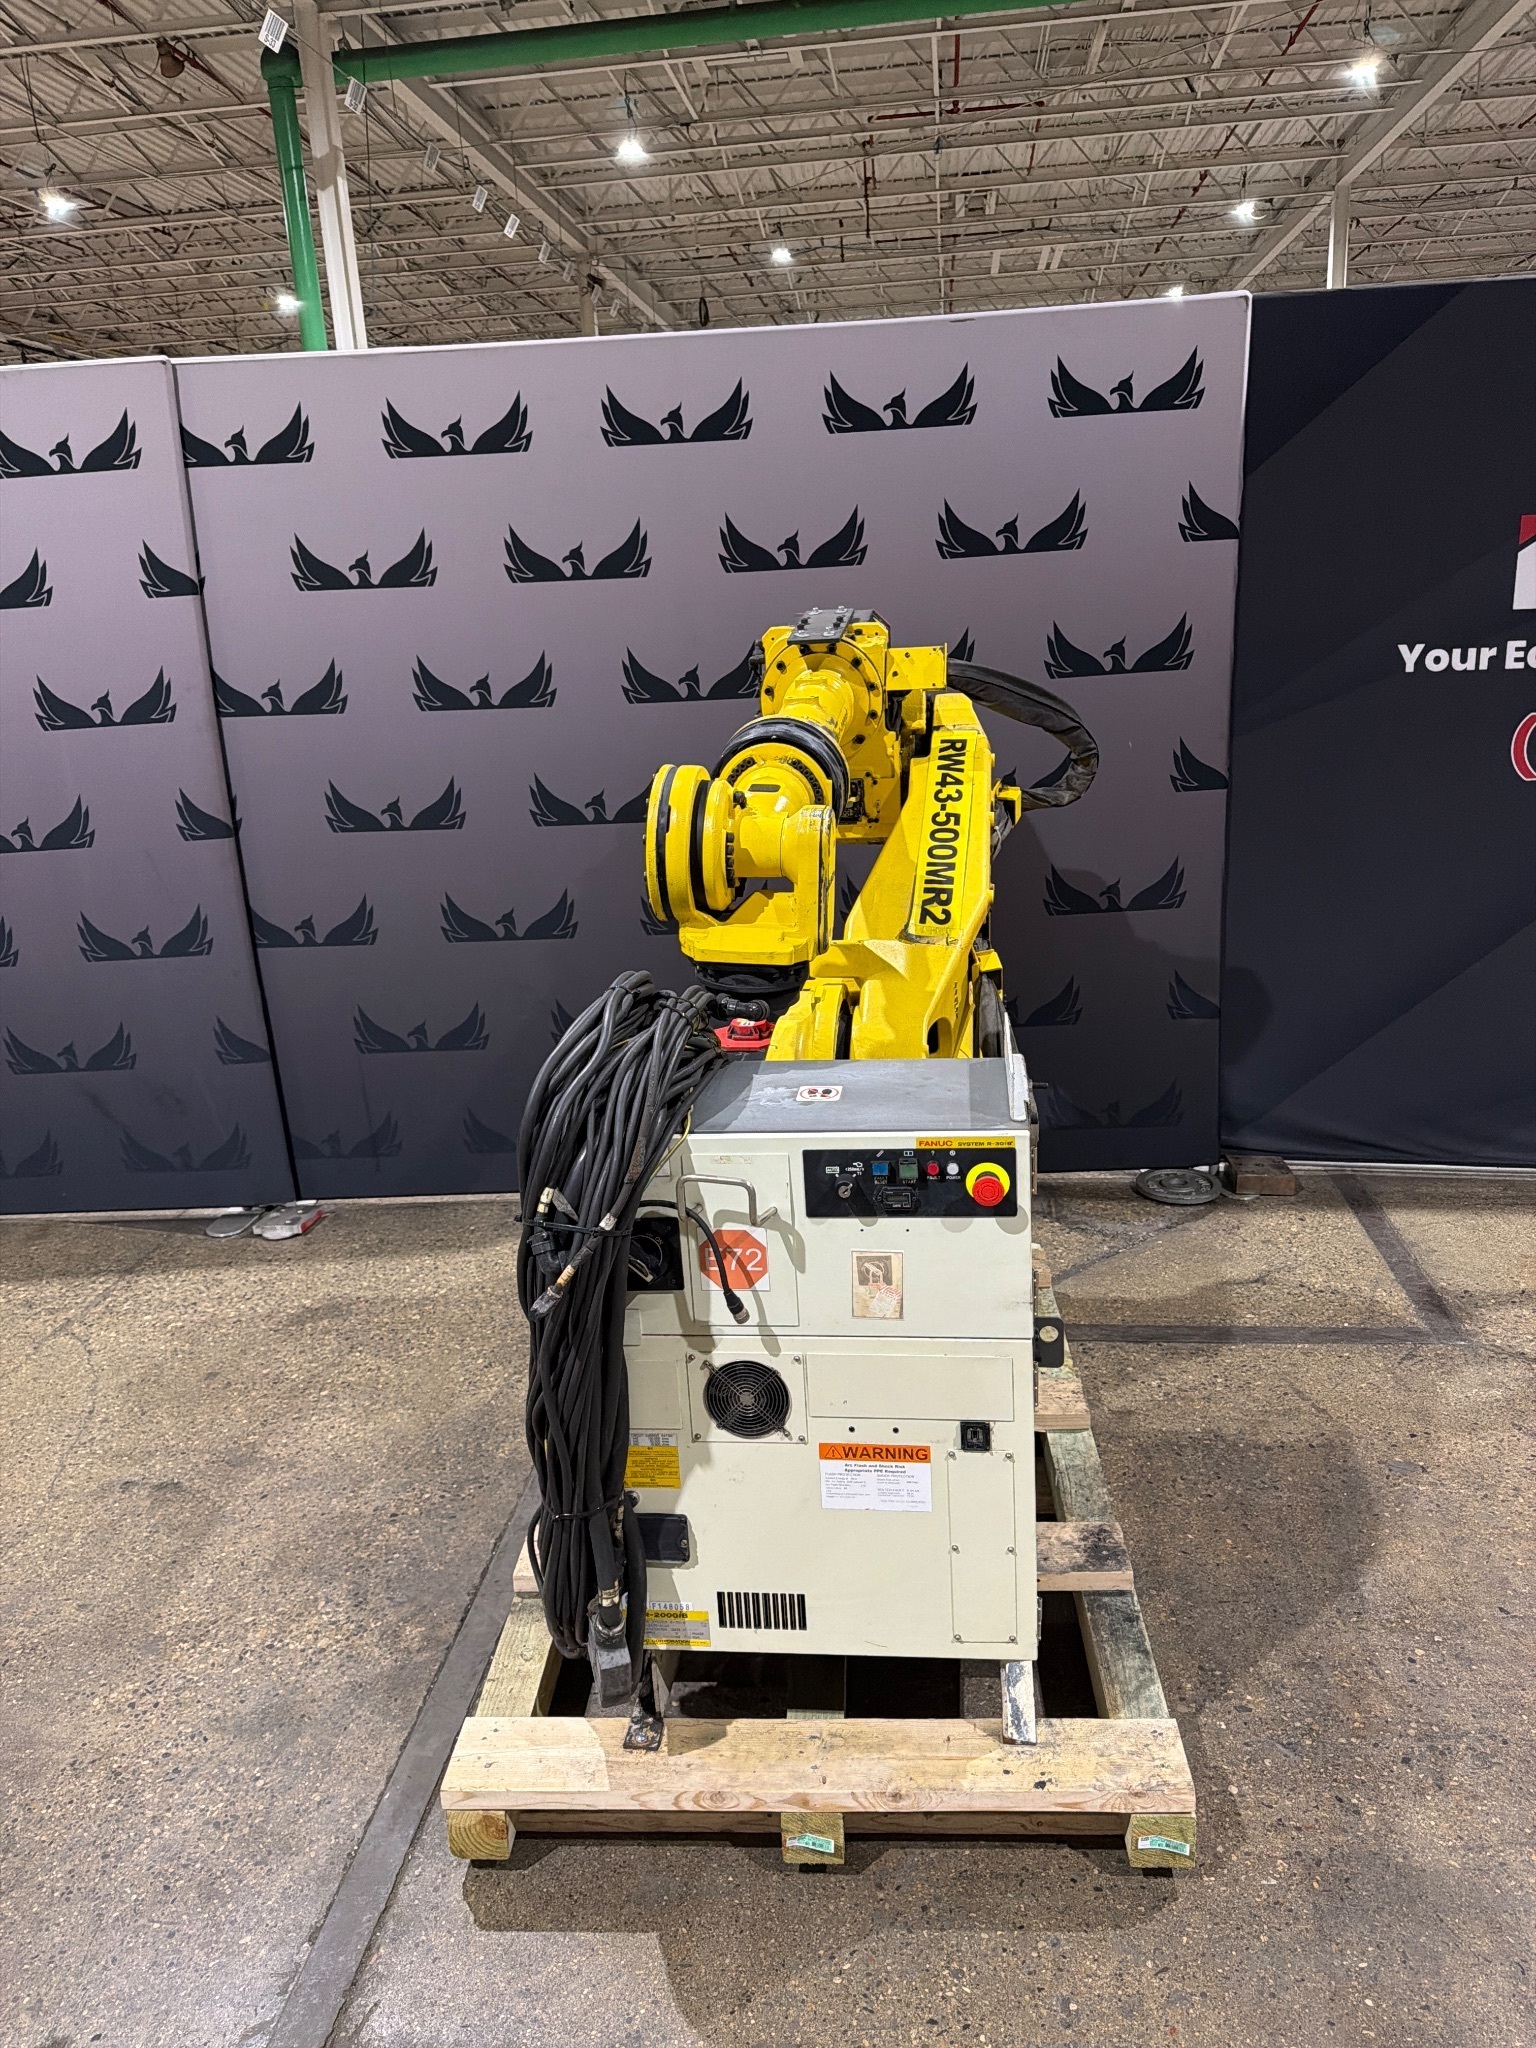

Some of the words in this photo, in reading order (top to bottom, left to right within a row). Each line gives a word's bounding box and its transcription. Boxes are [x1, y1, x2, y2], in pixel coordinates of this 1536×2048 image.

[263, 33, 277, 48] S-33
[1397, 643, 1497, 673] Your
[919, 738, 968, 926] RW43-500MR2
[704, 1247, 763, 1271] E72
[842, 1446, 928, 1461] WARNING
